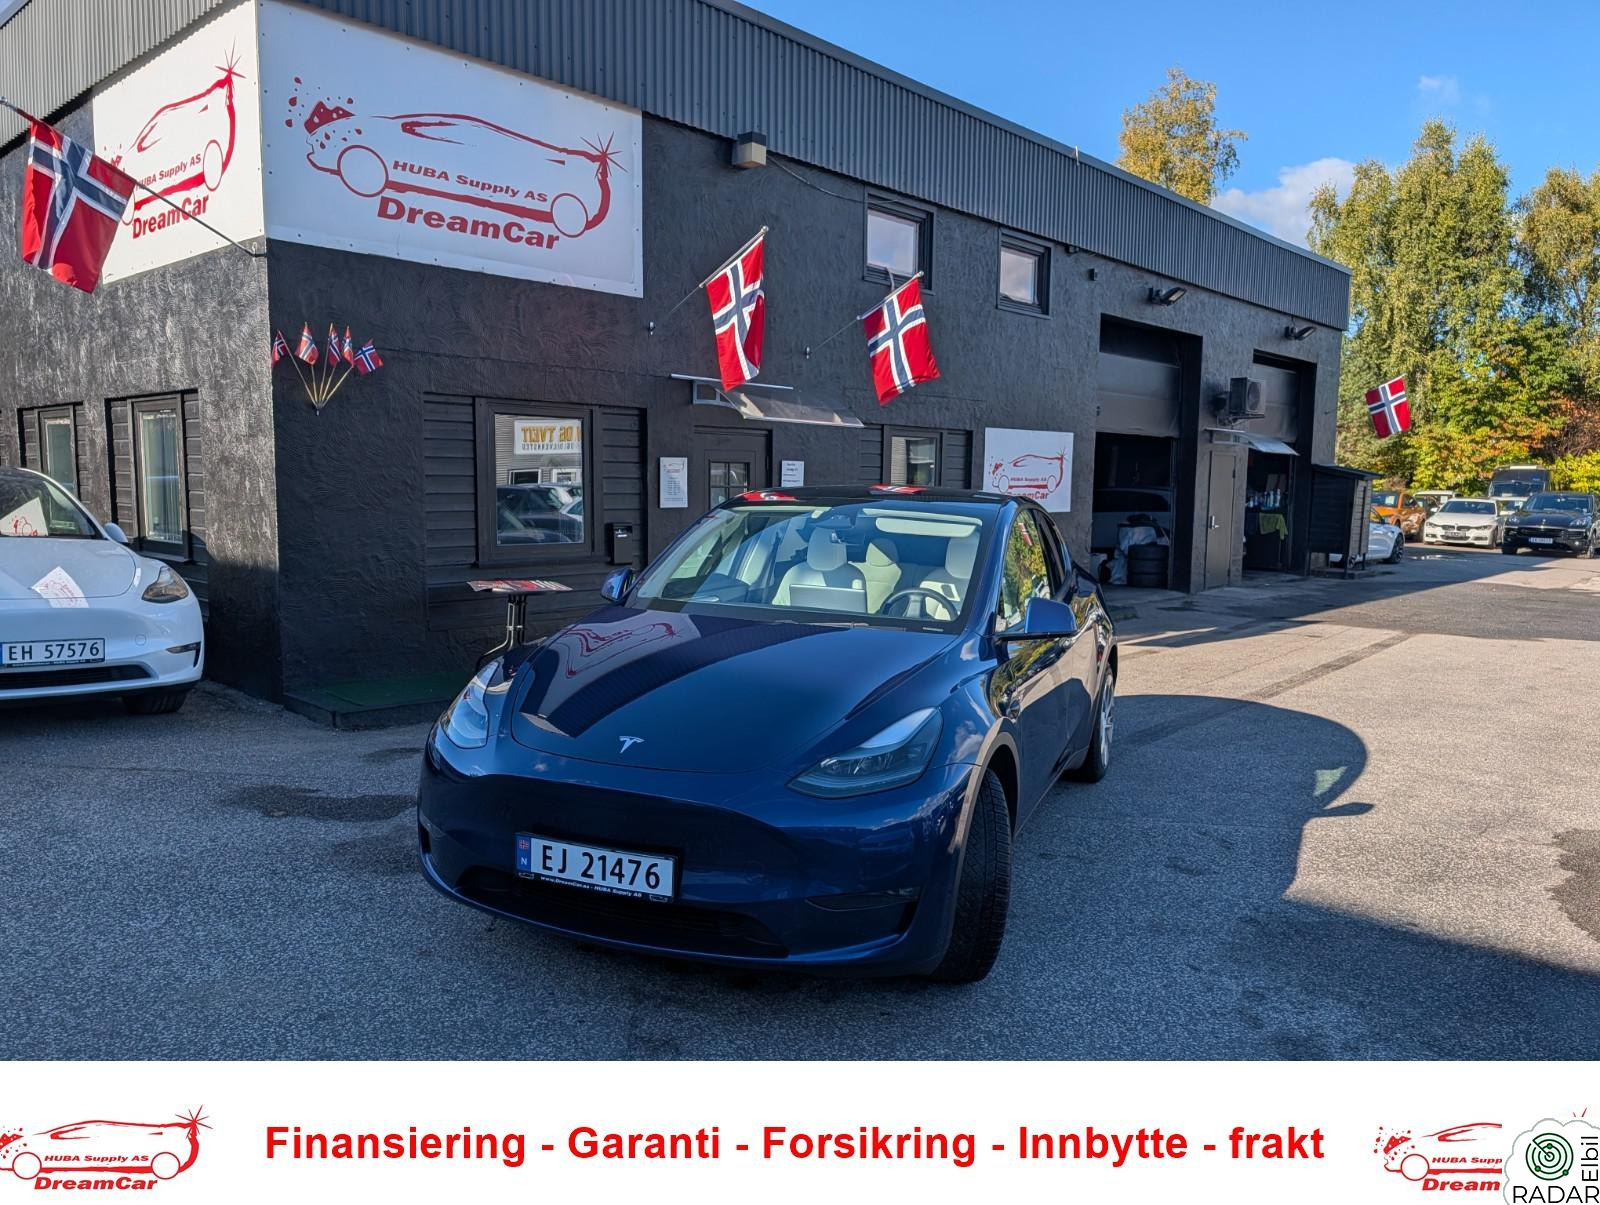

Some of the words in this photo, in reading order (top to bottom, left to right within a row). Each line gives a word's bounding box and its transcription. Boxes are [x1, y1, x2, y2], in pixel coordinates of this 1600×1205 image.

[158, 161, 188, 181] Supply
[189, 153, 202, 168] AS
[392, 160, 450, 182] HUBA
[455, 174, 521, 199] Supply
[523, 190, 549, 203] AS
[132, 194, 209, 240] DreamCar
[377, 195, 560, 250] DreamCar
[8, 645, 33, 661] EH
[44, 642, 100, 660] 57576
[542, 844, 567, 874] EJ
[580, 851, 660, 889] 21476
